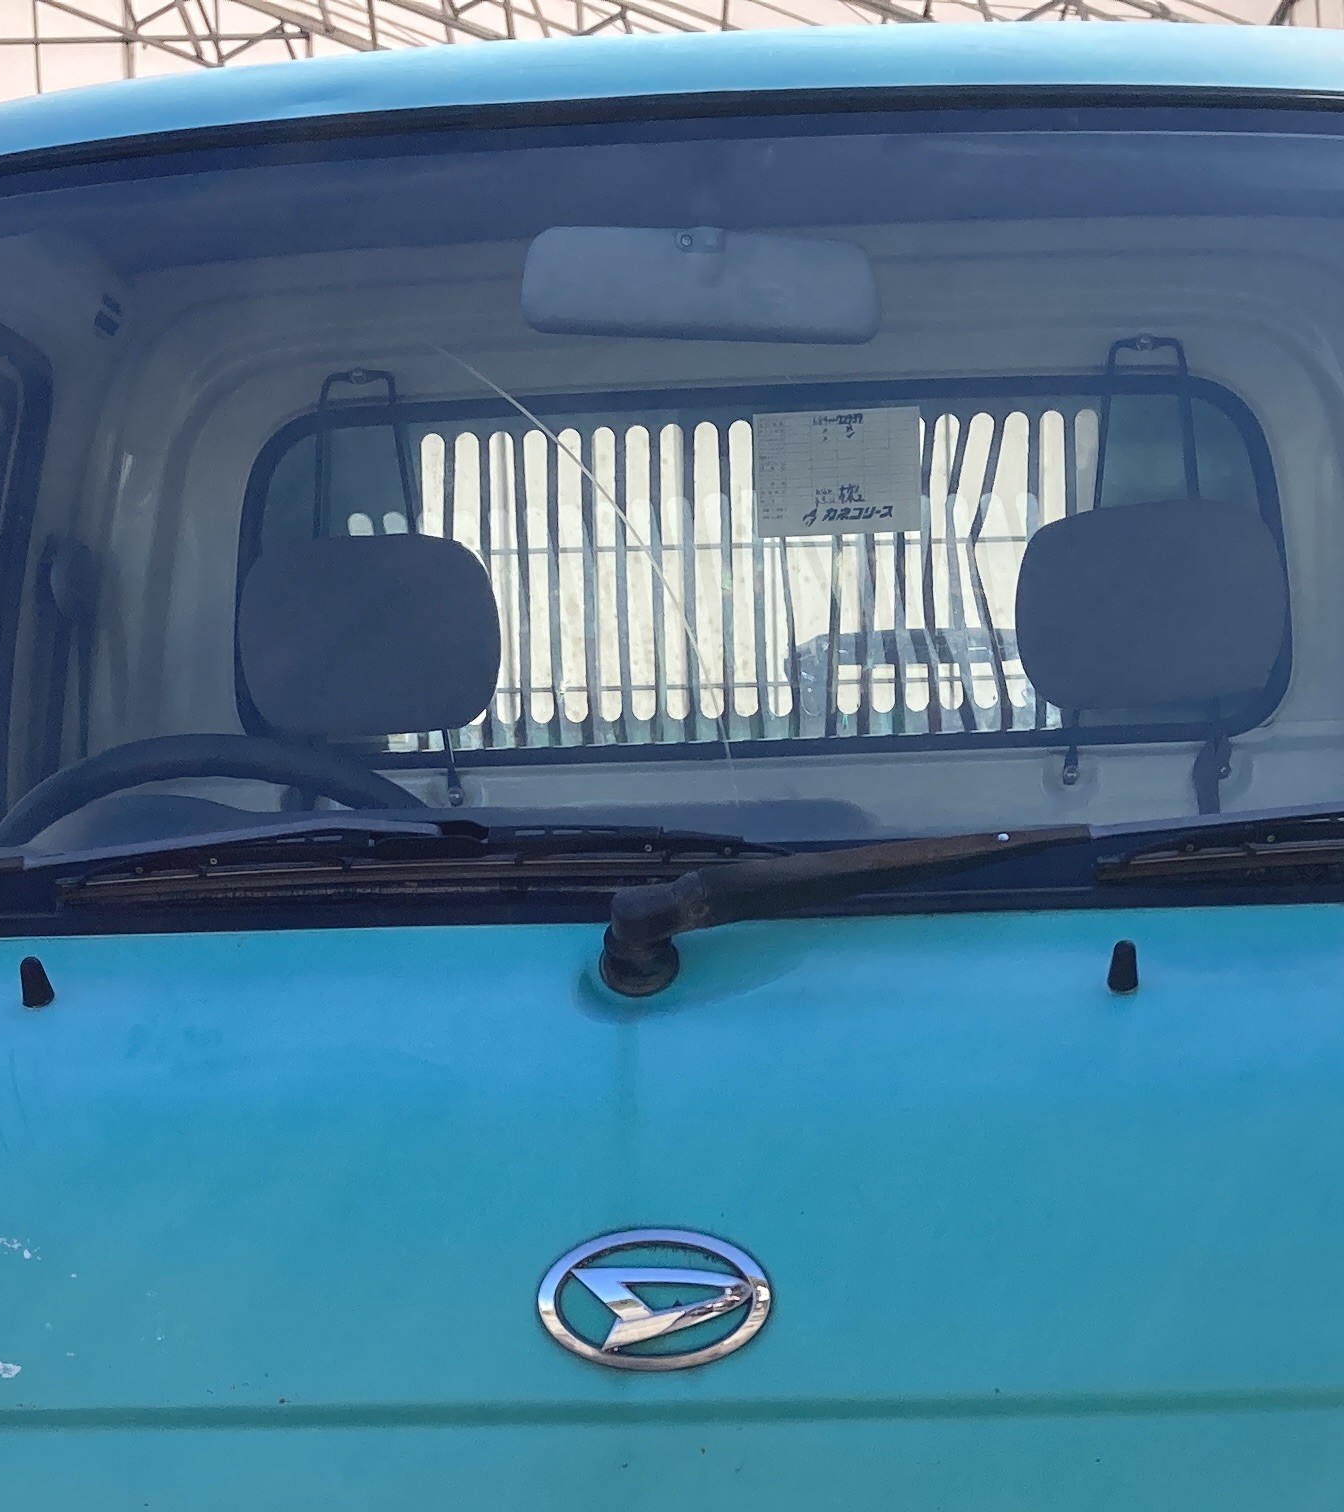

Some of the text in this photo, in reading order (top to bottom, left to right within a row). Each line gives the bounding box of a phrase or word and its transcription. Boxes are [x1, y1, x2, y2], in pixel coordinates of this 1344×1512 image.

[822, 505, 893, 521] カネコリース
